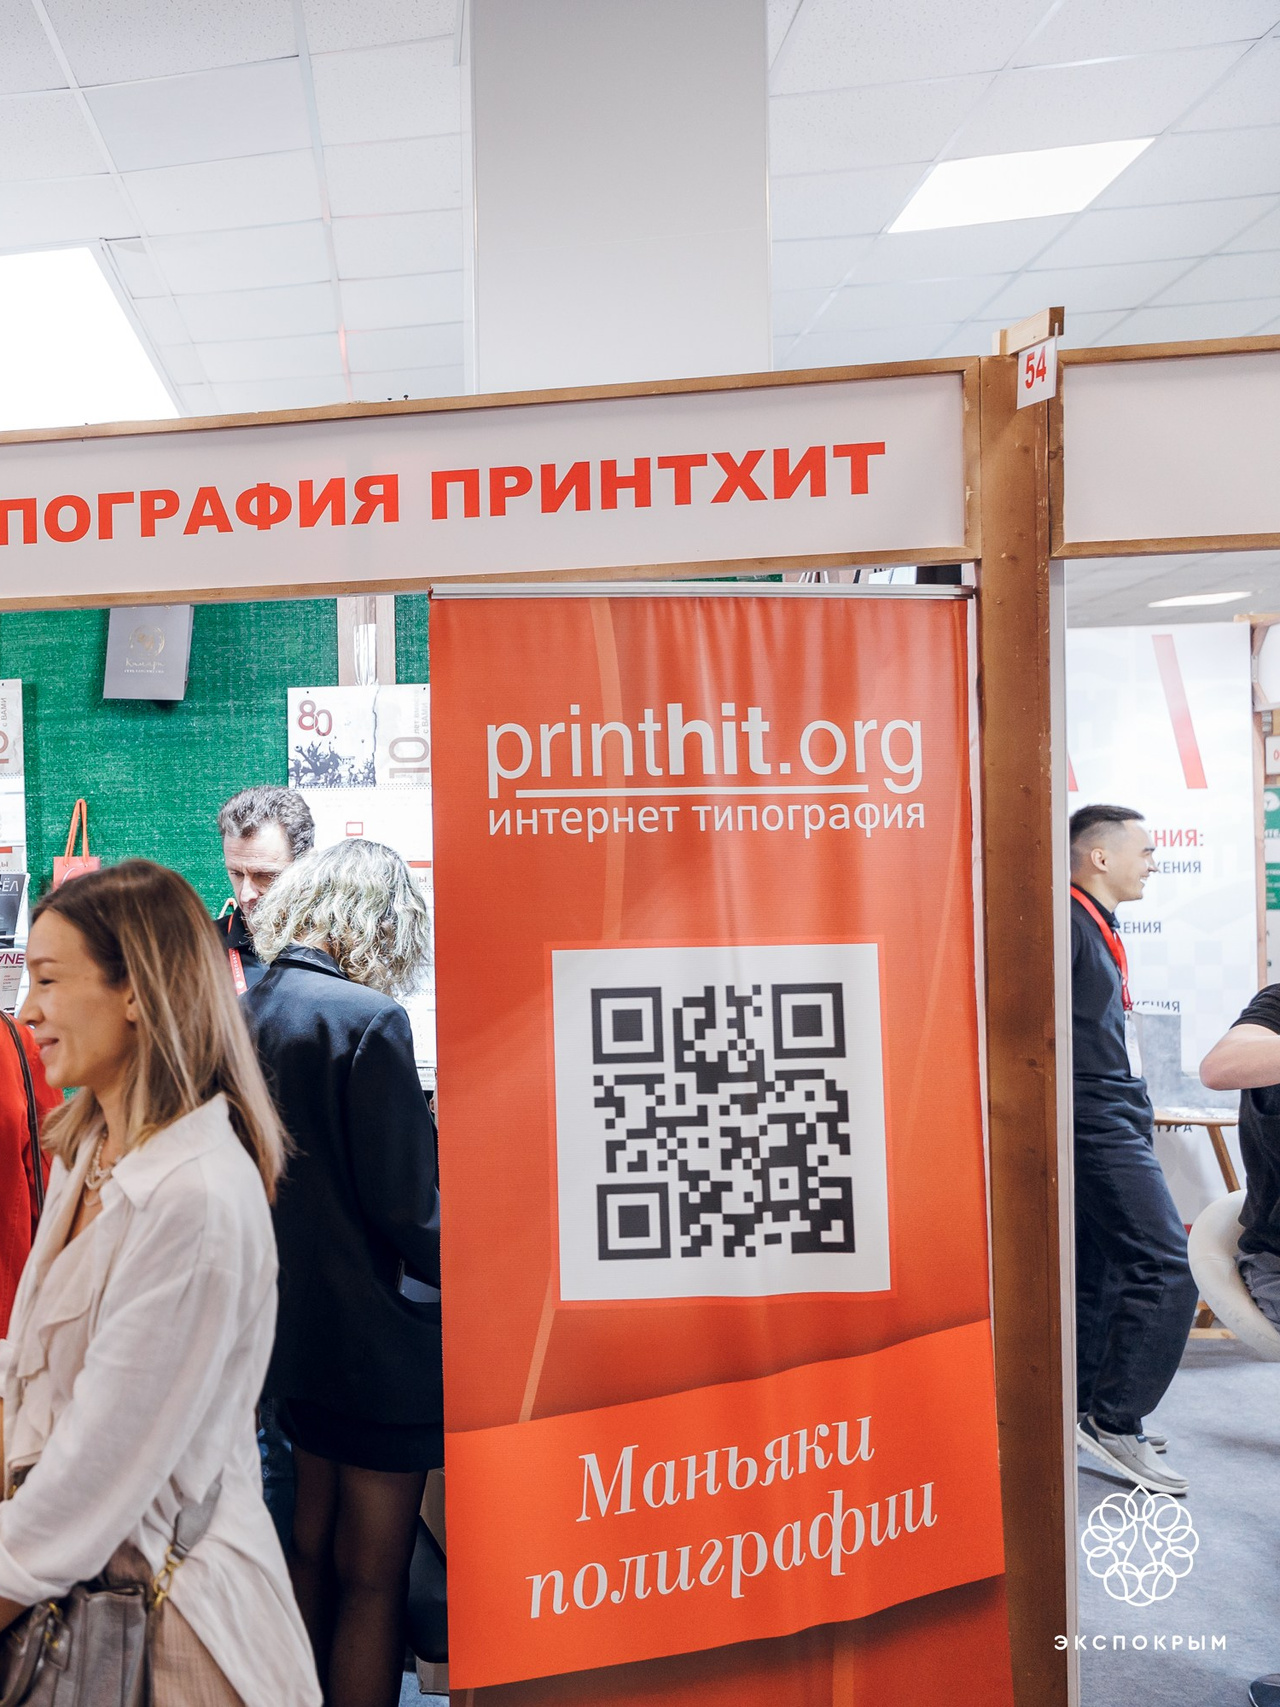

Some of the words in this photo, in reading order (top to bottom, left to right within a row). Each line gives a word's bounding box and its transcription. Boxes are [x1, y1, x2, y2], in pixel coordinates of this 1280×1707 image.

[1025, 346, 1047, 389] 54
[431, 441, 886, 520] ПРИНТХИТ
[298, 700, 332, 736] 80
[487, 703, 923, 799] printhit.org
[489, 806, 679, 842] интернет
[692, 802, 925, 838] типография
[576, 1416, 875, 1523] Маньяки
[525, 1482, 937, 1619] полиграфии
